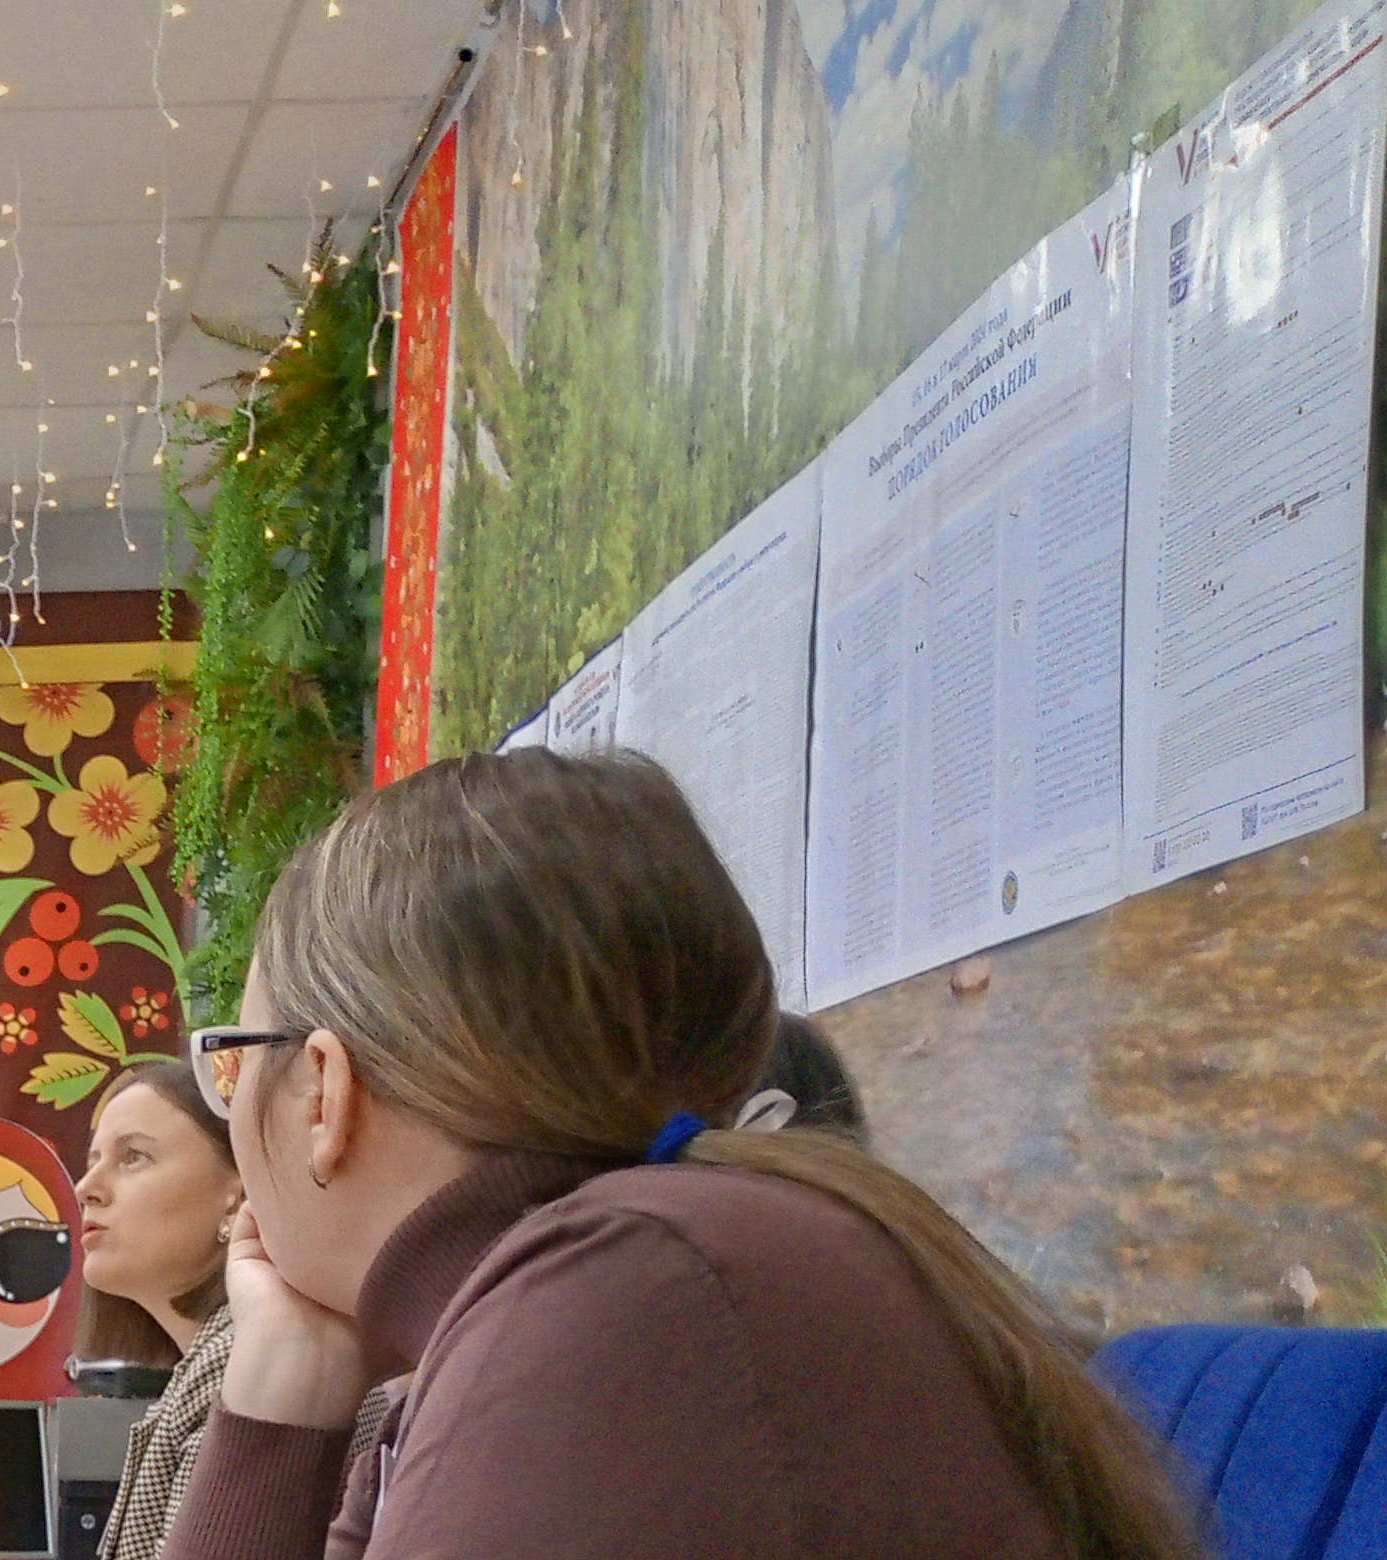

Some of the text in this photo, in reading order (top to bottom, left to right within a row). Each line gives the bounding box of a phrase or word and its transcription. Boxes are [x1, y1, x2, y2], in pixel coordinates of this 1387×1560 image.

[951, 339, 1005, 401] Российской
[888, 439, 937, 500] ПОРЯДОК
[940, 352, 1038, 453] ГОЛОСОВАНИЯ
